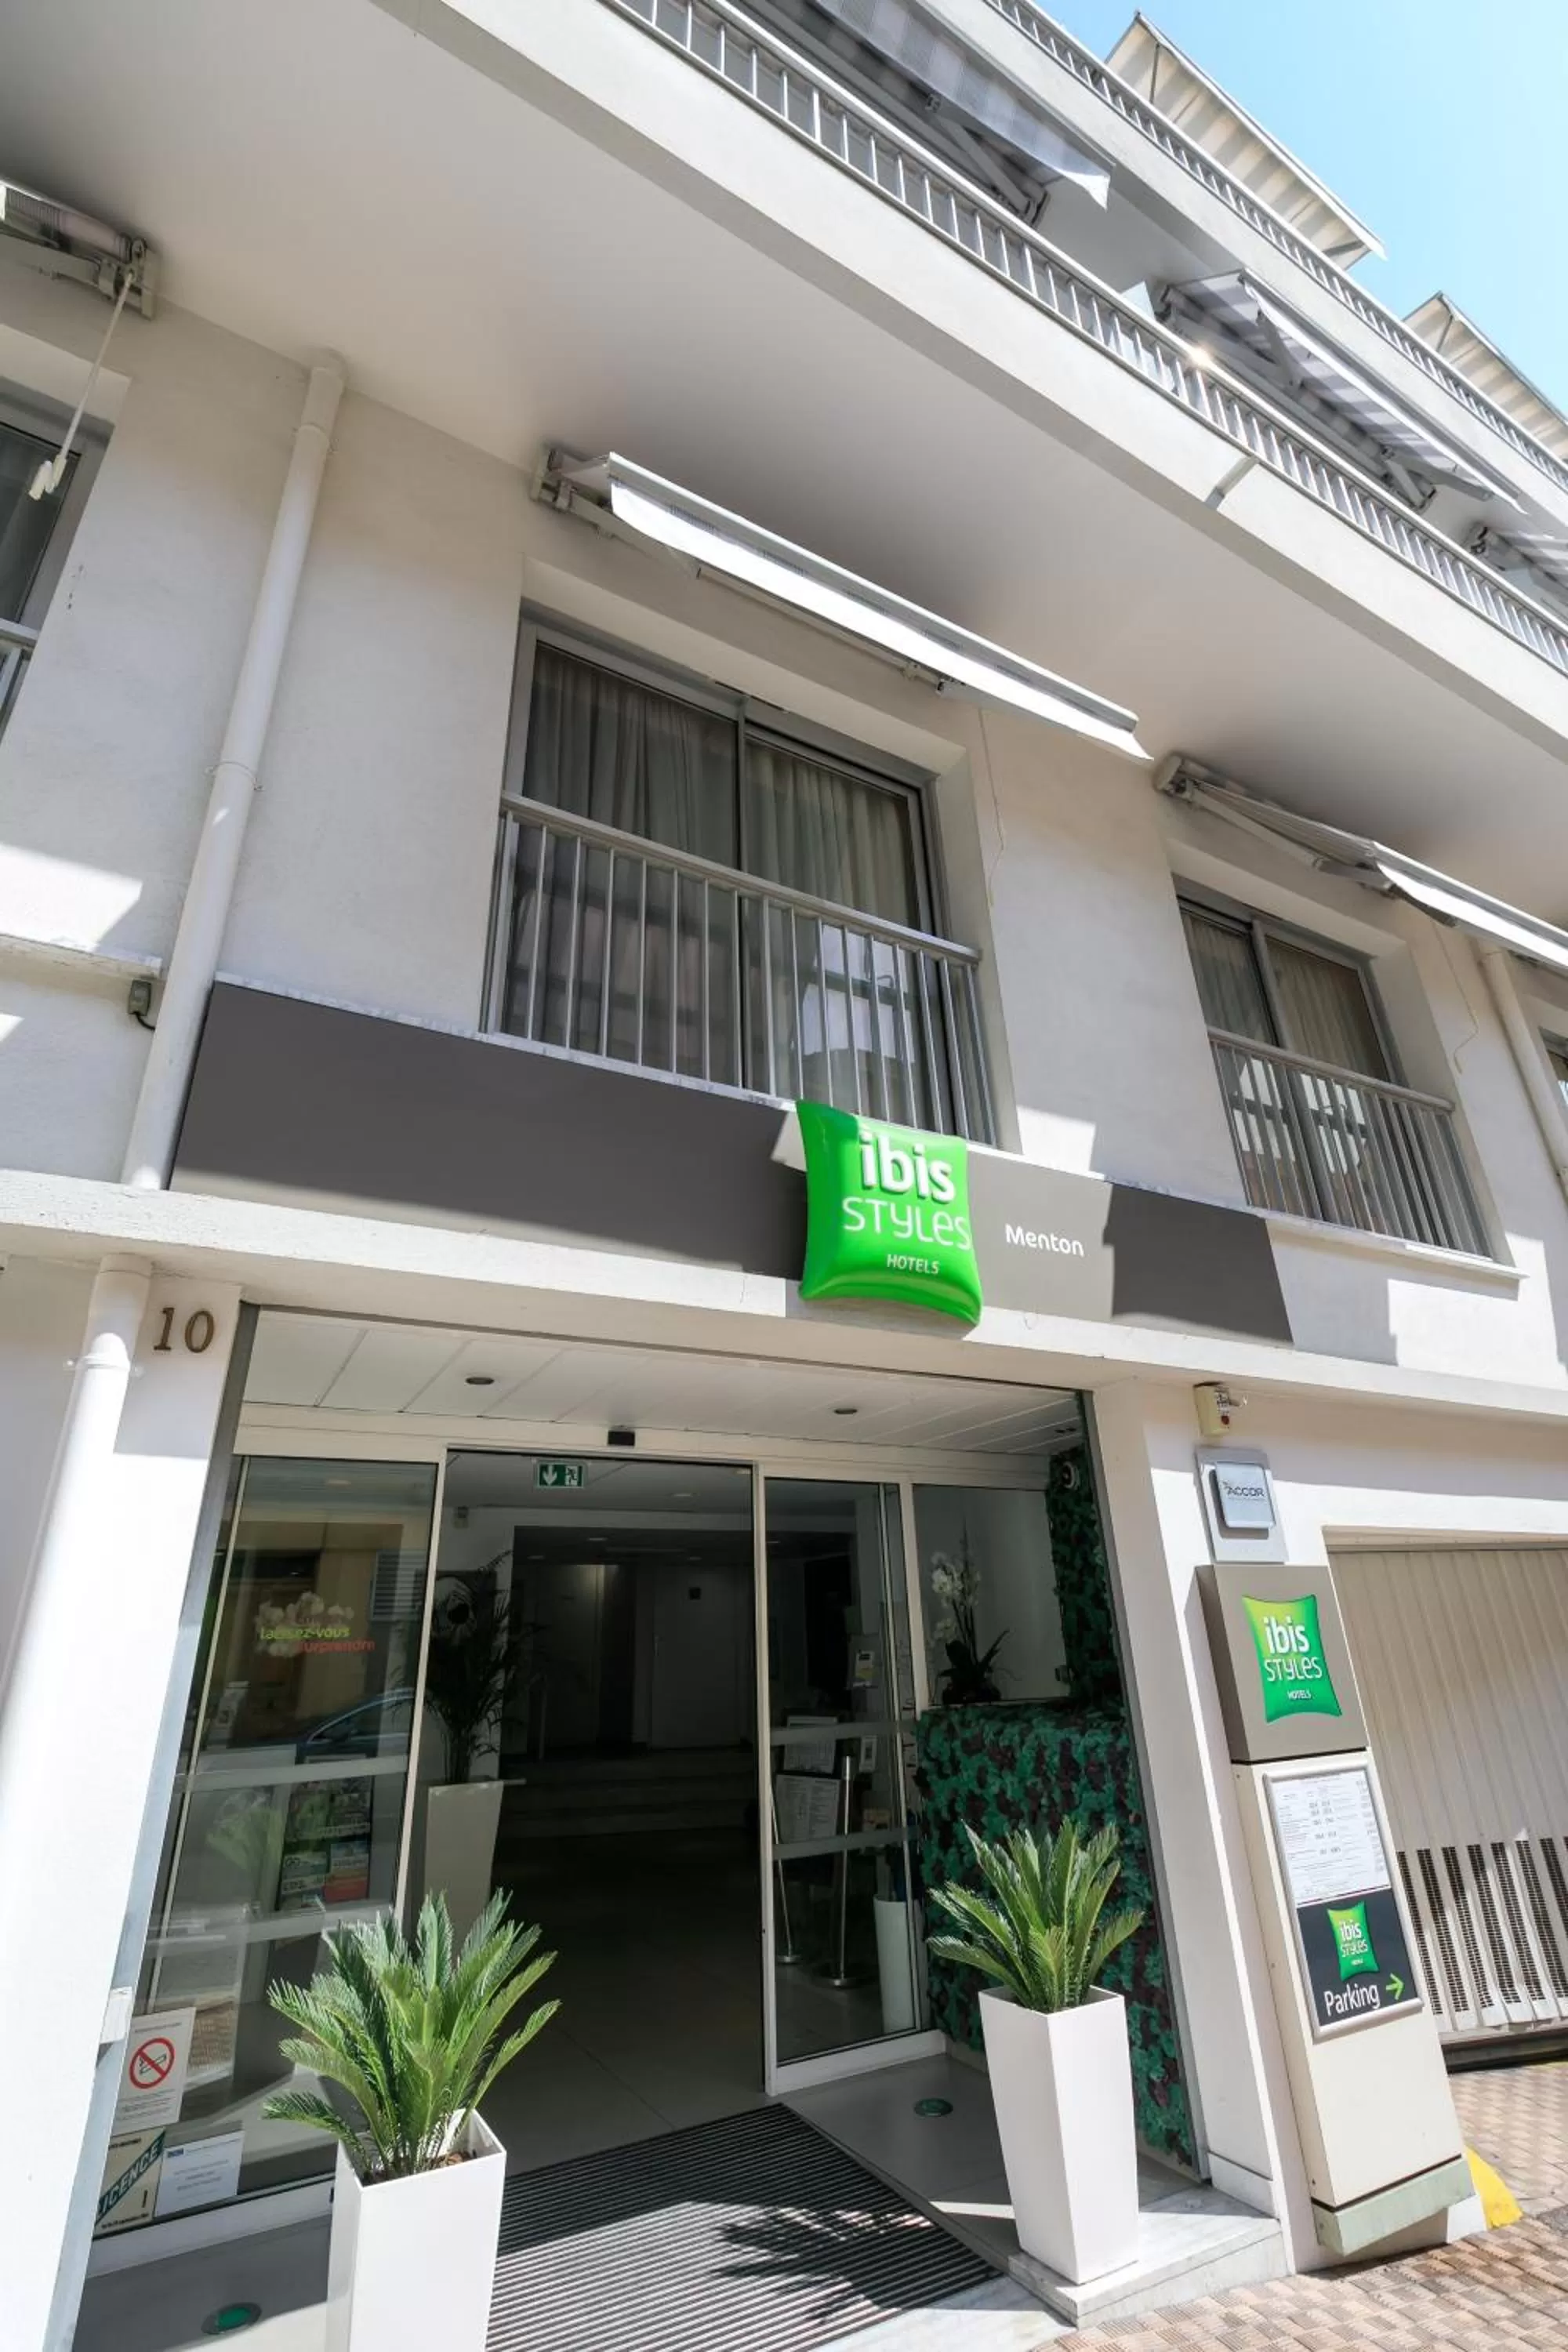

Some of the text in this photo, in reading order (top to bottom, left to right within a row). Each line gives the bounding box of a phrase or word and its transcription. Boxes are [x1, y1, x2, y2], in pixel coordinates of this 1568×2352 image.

[859, 1129, 956, 1203] ibis
[1005, 1224, 1084, 1258] Menton
[887, 1254, 940, 1276] HOTELS
[153, 1306, 215, 1354] 10
[1225, 1486, 1265, 1497] ACCOR
[1263, 1616, 1310, 1654] ibis
[1287, 1689, 1312, 1700] HOTELS
[1338, 1918, 1363, 1941] ibis
[1323, 1983, 1381, 2017] Parking
